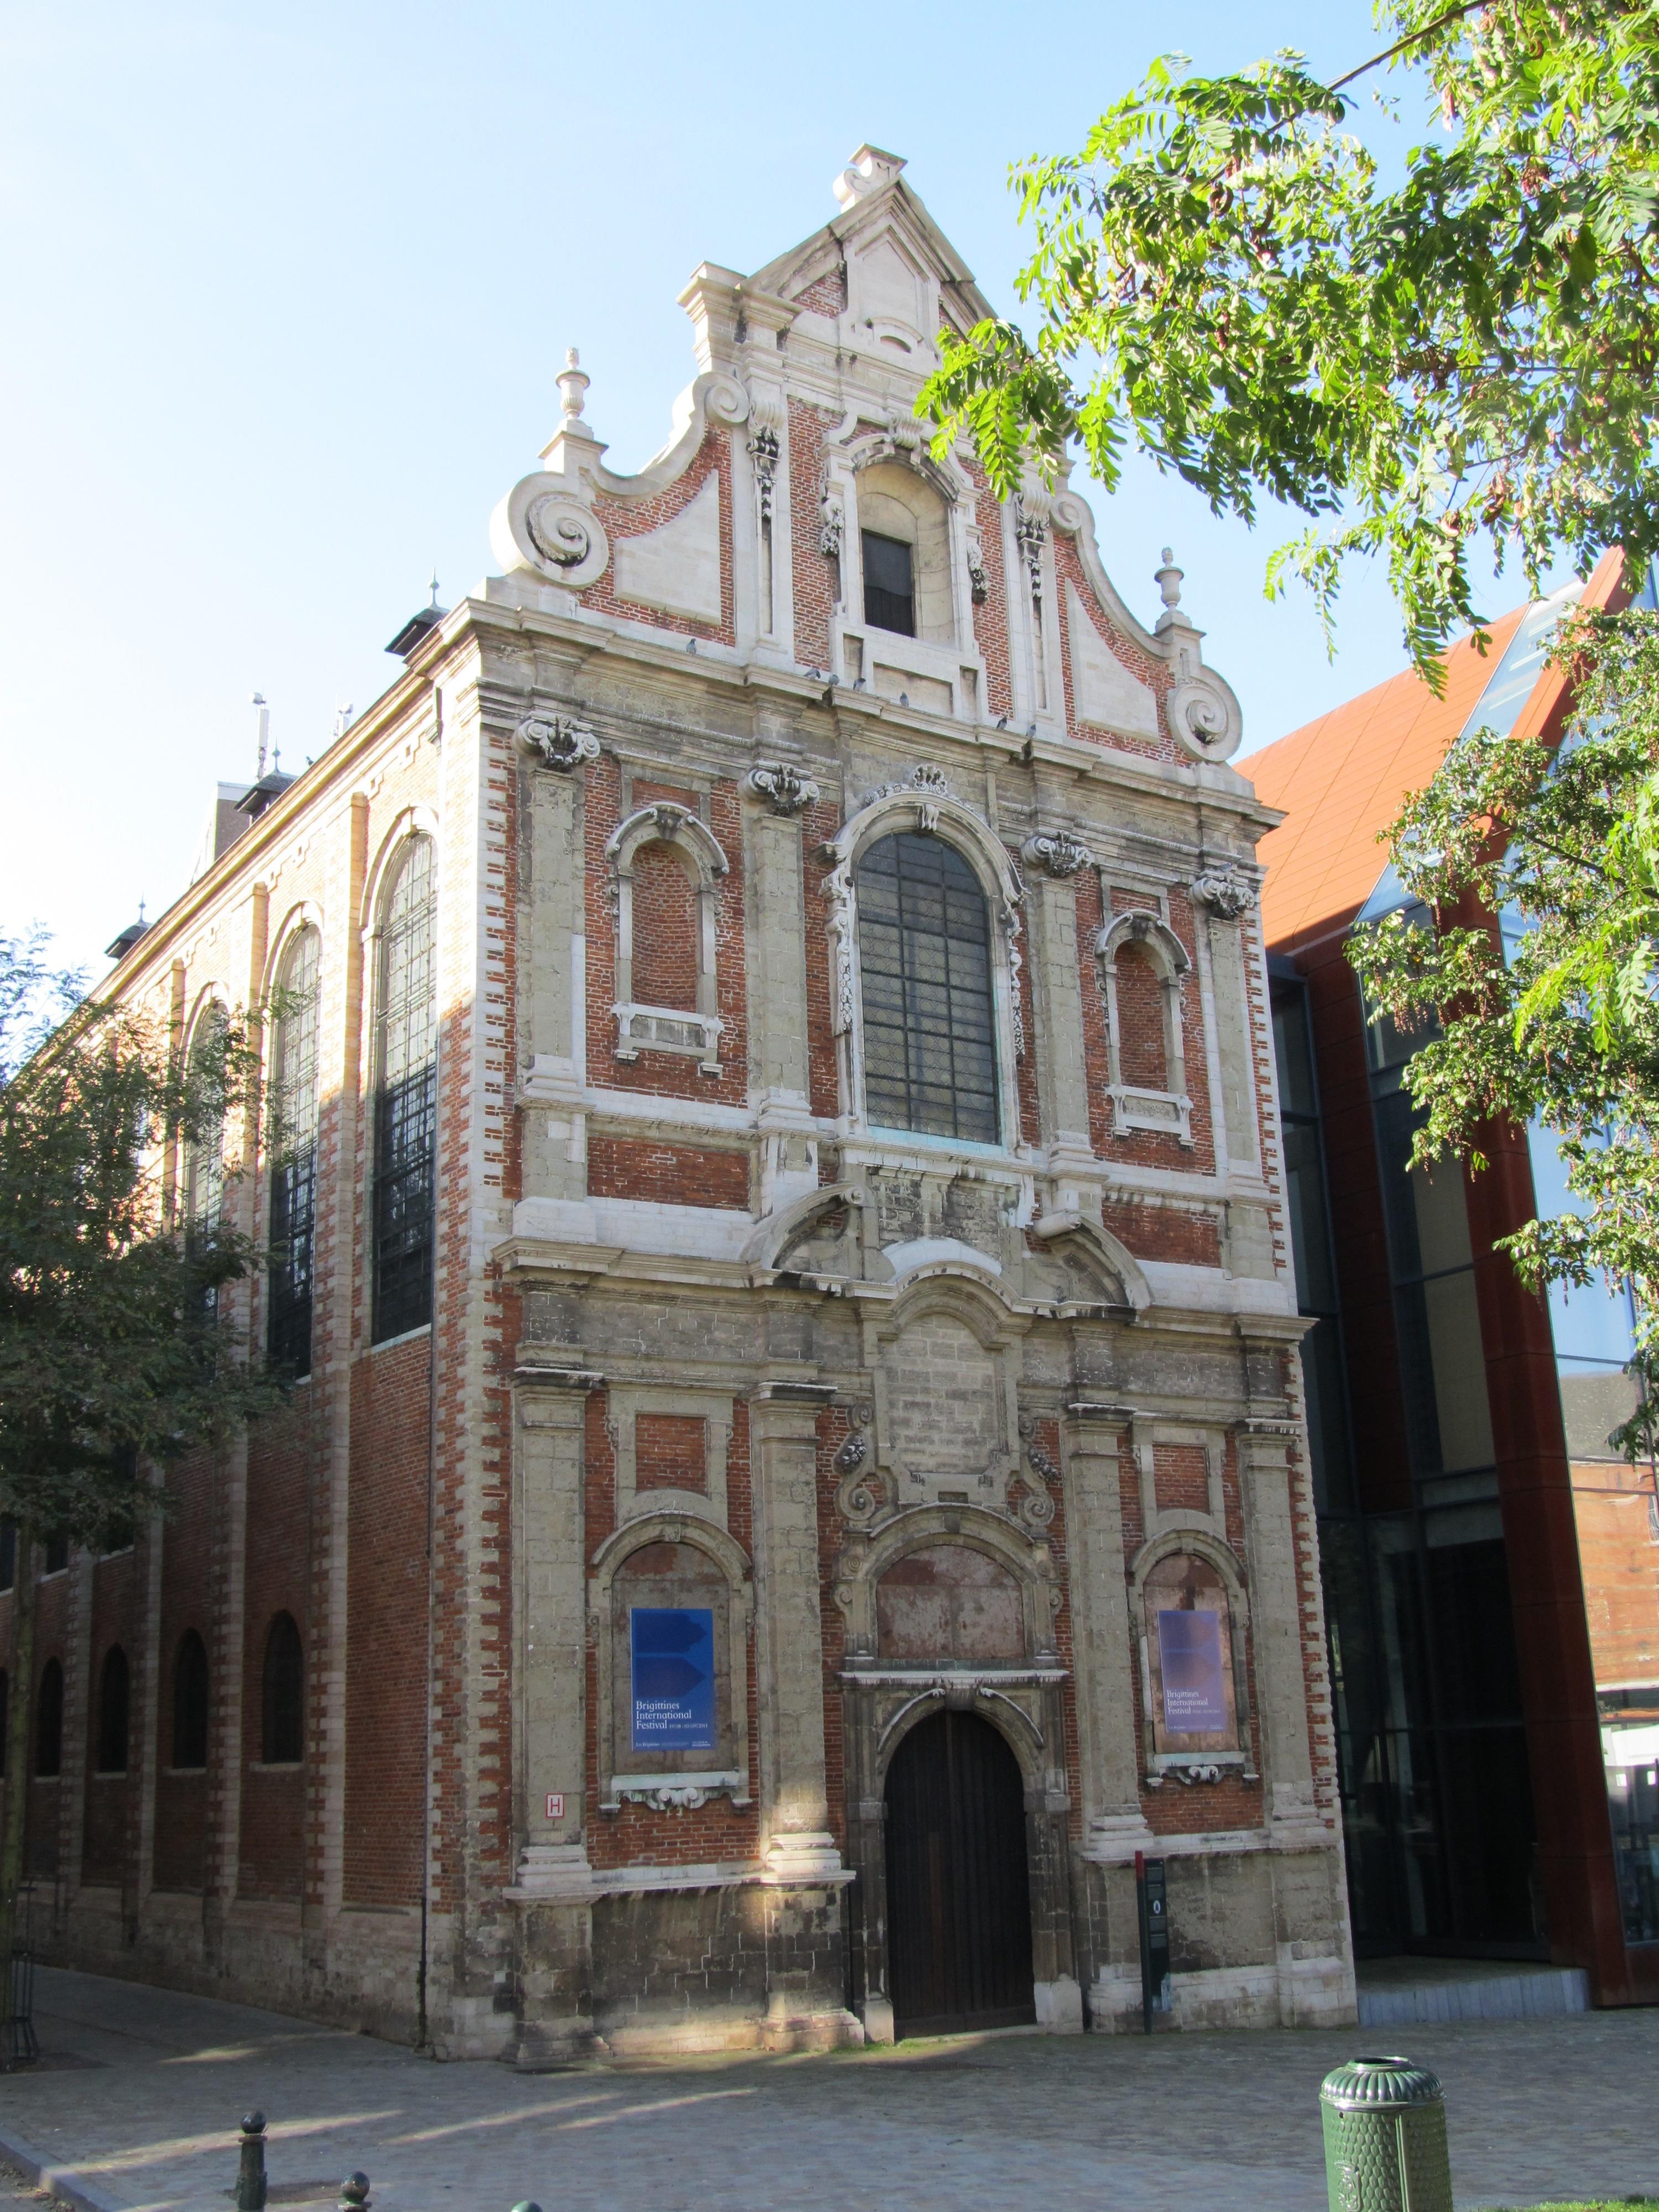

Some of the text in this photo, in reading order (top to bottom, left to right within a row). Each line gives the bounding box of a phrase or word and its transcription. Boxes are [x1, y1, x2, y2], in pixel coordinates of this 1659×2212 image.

[1166, 1689, 1199, 1699] Brigittines
[636, 1700, 680, 1712] Brigittines
[1167, 1697, 1208, 1706] International
[637, 1709, 691, 1719] International
[1168, 1705, 1191, 1714] Festival
[637, 1719, 667, 1729] Festival
[550, 1798, 560, 1813] H
